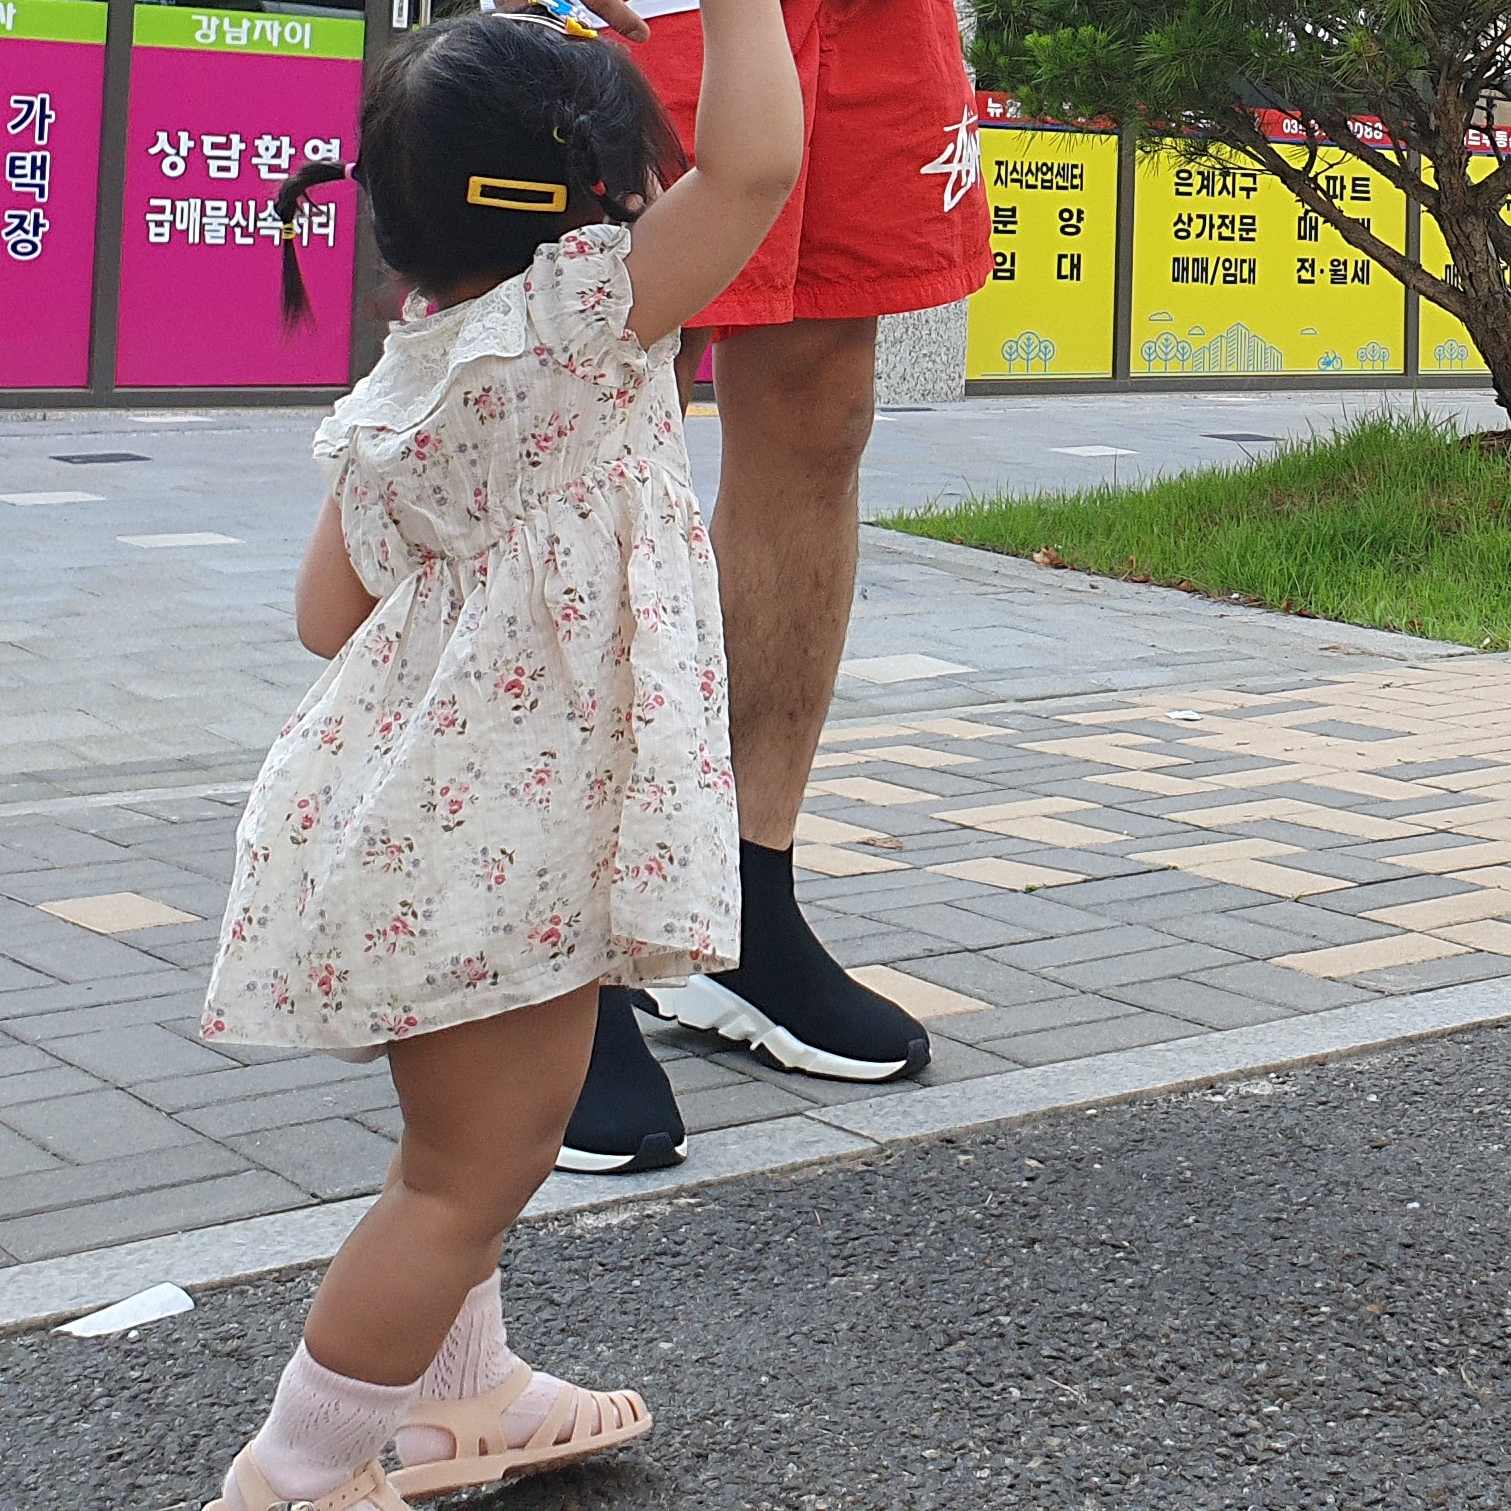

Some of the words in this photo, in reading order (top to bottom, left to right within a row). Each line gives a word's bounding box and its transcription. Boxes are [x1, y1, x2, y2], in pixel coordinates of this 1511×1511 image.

[191, 14, 312, 49] 강남자이
[994, 160, 1084, 192] 지식산업센터
[1173, 171, 1258, 200] 은계지구
[1308, 174, 1371, 202] 파트
[1172, 212, 1257, 242] 상가전문
[1171, 256, 1256, 286] 매매/임대
